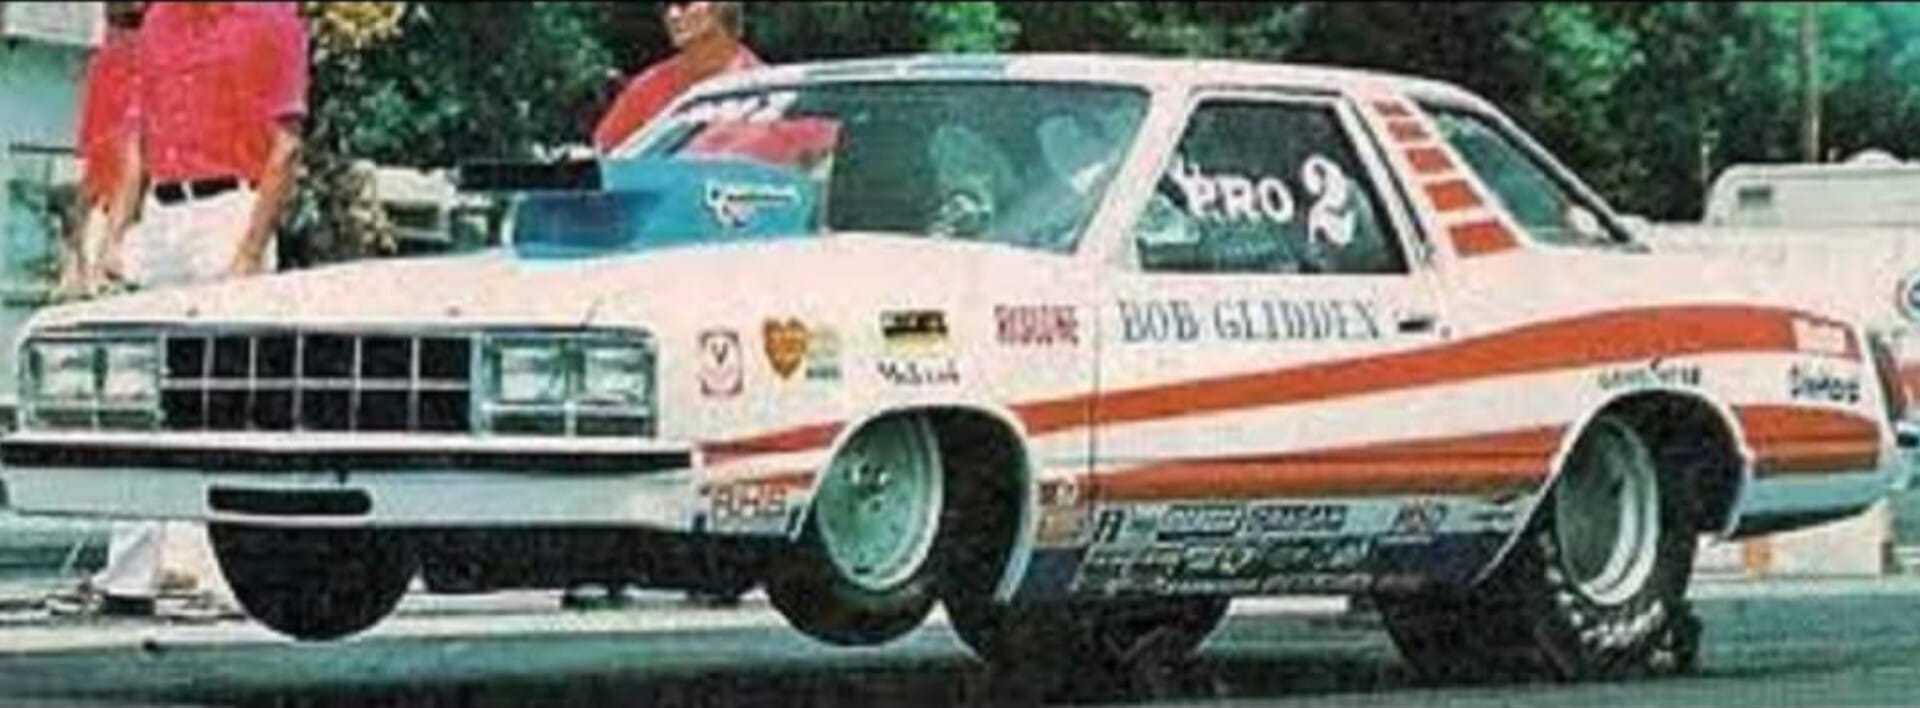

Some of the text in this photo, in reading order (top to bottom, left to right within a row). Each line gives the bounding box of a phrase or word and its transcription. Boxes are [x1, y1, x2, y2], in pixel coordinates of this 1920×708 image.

[1184, 154, 1354, 246] PRO 2
[1119, 300, 1200, 342] BOB
